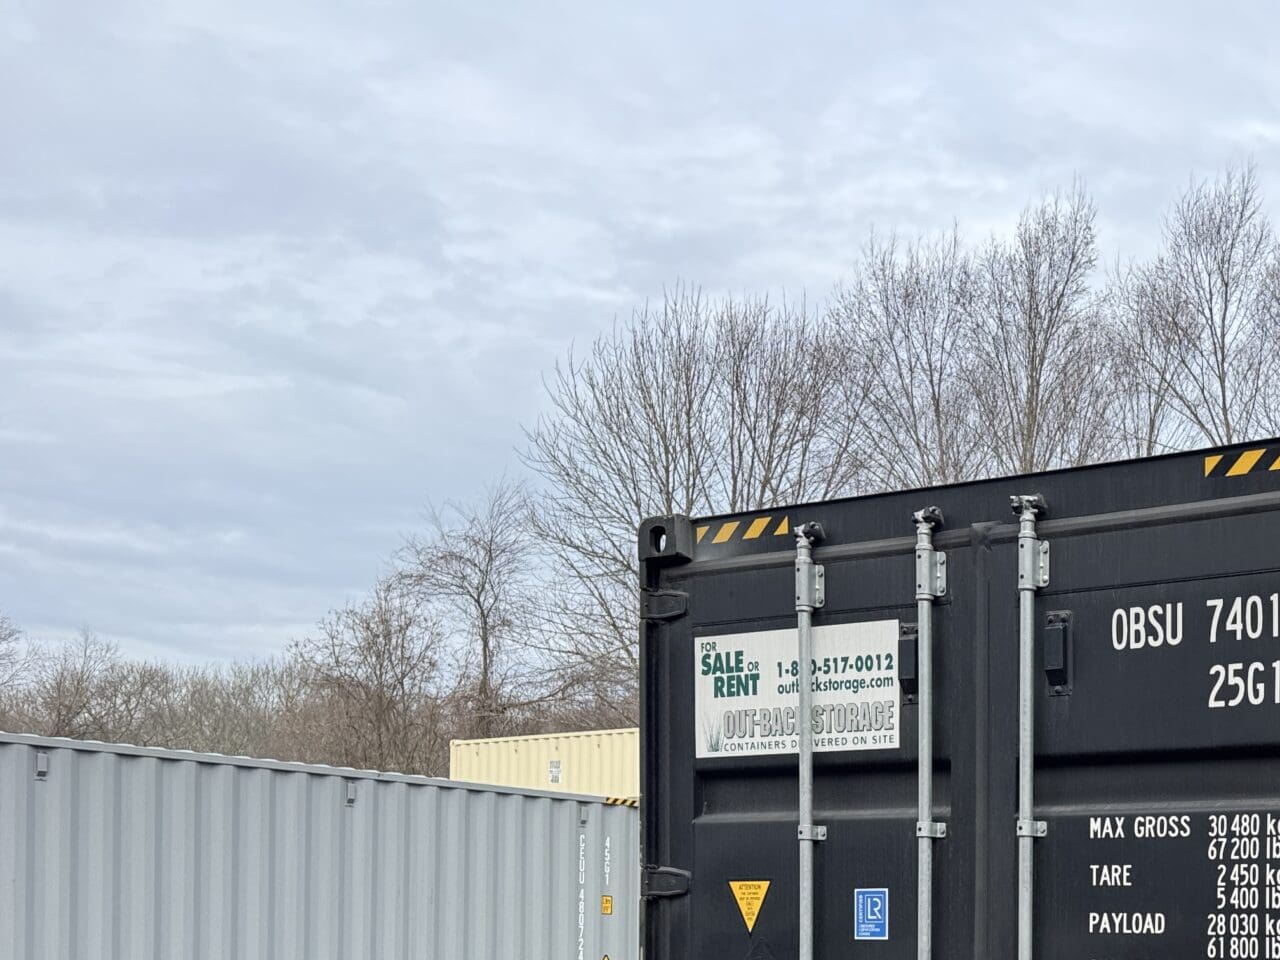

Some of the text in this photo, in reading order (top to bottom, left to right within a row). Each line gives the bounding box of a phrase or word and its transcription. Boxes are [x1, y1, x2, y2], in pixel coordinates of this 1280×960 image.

[1111, 602, 1183, 650] OBSU
[701, 642, 716, 653] FOR
[701, 650, 760, 676] SALE OR
[777, 653, 894, 678] 1-80-517-0012
[713, 672, 760, 698] RENT
[1208, 659, 1280, 708] 25G1
[811, 700, 895, 734] STORAGE
[723, 734, 895, 752] CONTAINERS DVERED ON SITE
[1089, 817, 1125, 838] MAX
[1134, 816, 1191, 838] GROSS
[1089, 864, 1132, 886] TARE
[1088, 912, 1166, 934] PAYLOAD
